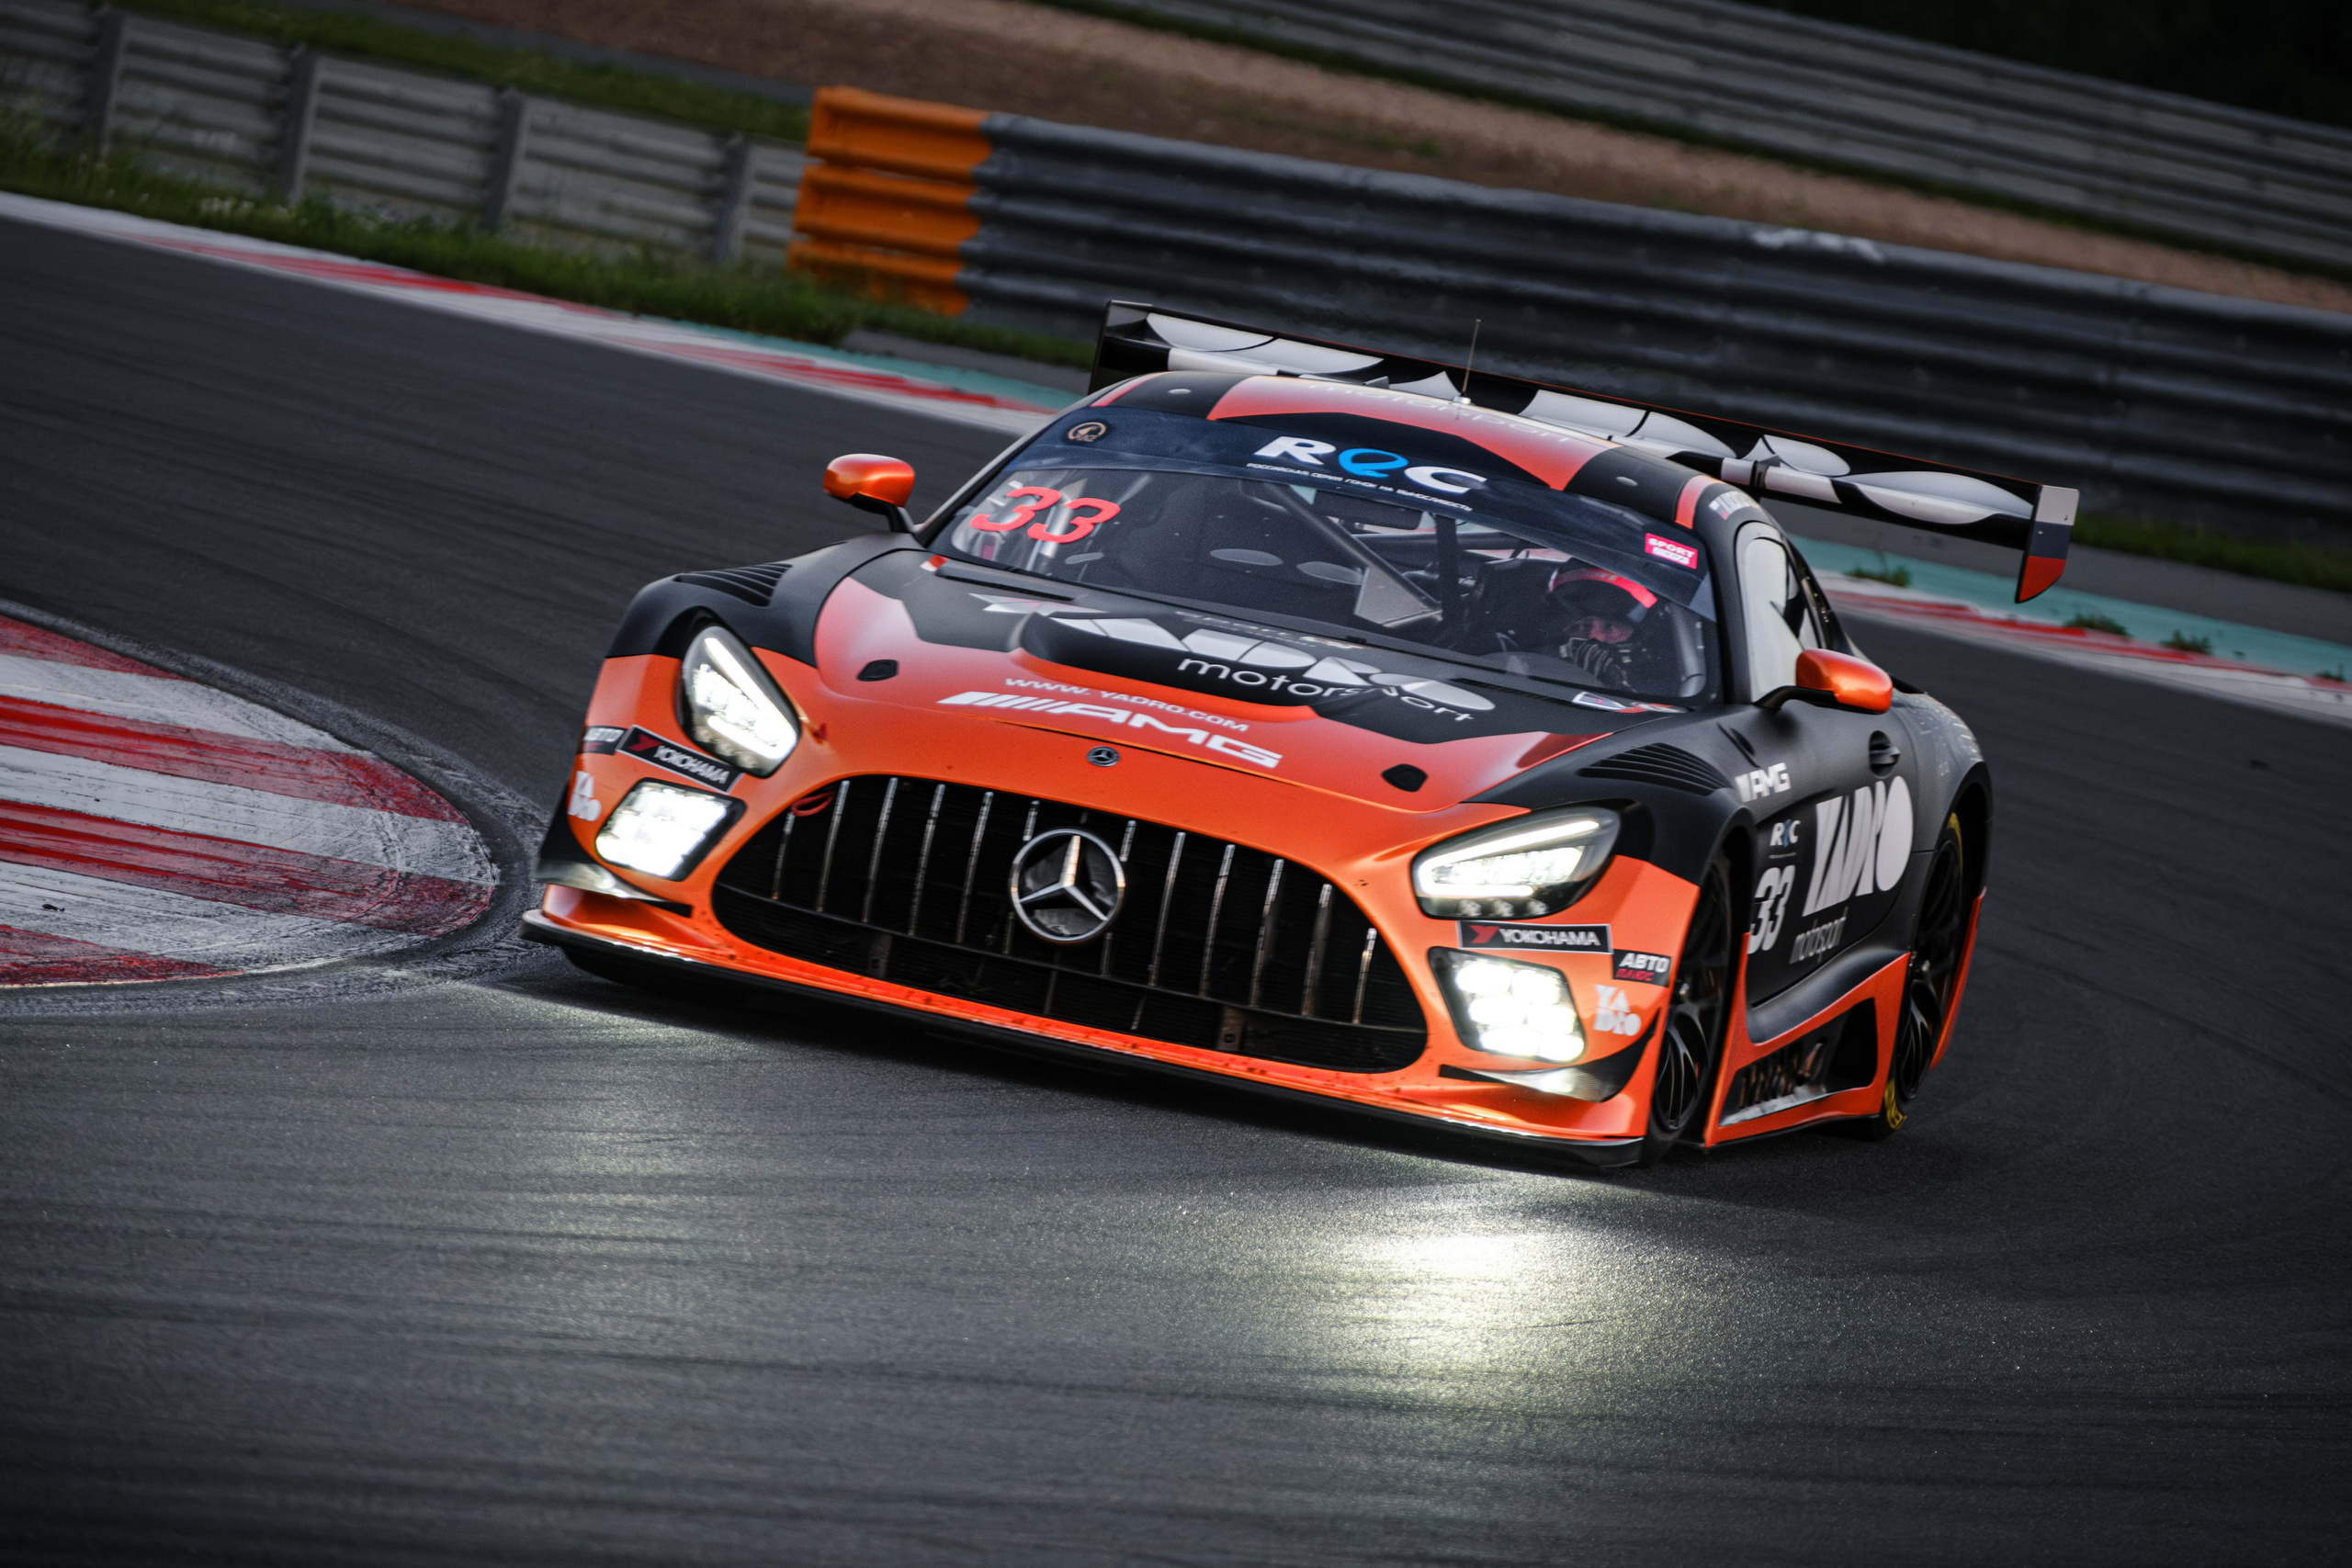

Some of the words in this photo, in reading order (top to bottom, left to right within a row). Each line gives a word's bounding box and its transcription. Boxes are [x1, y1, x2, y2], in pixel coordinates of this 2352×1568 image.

[968, 486, 1121, 544] 33
[1648, 537, 1696, 558] SPORT
[653, 745, 730, 784] YOKOHAMA
[1747, 864, 1796, 954] 33
[1498, 928, 1601, 946] YOKOHAMA
